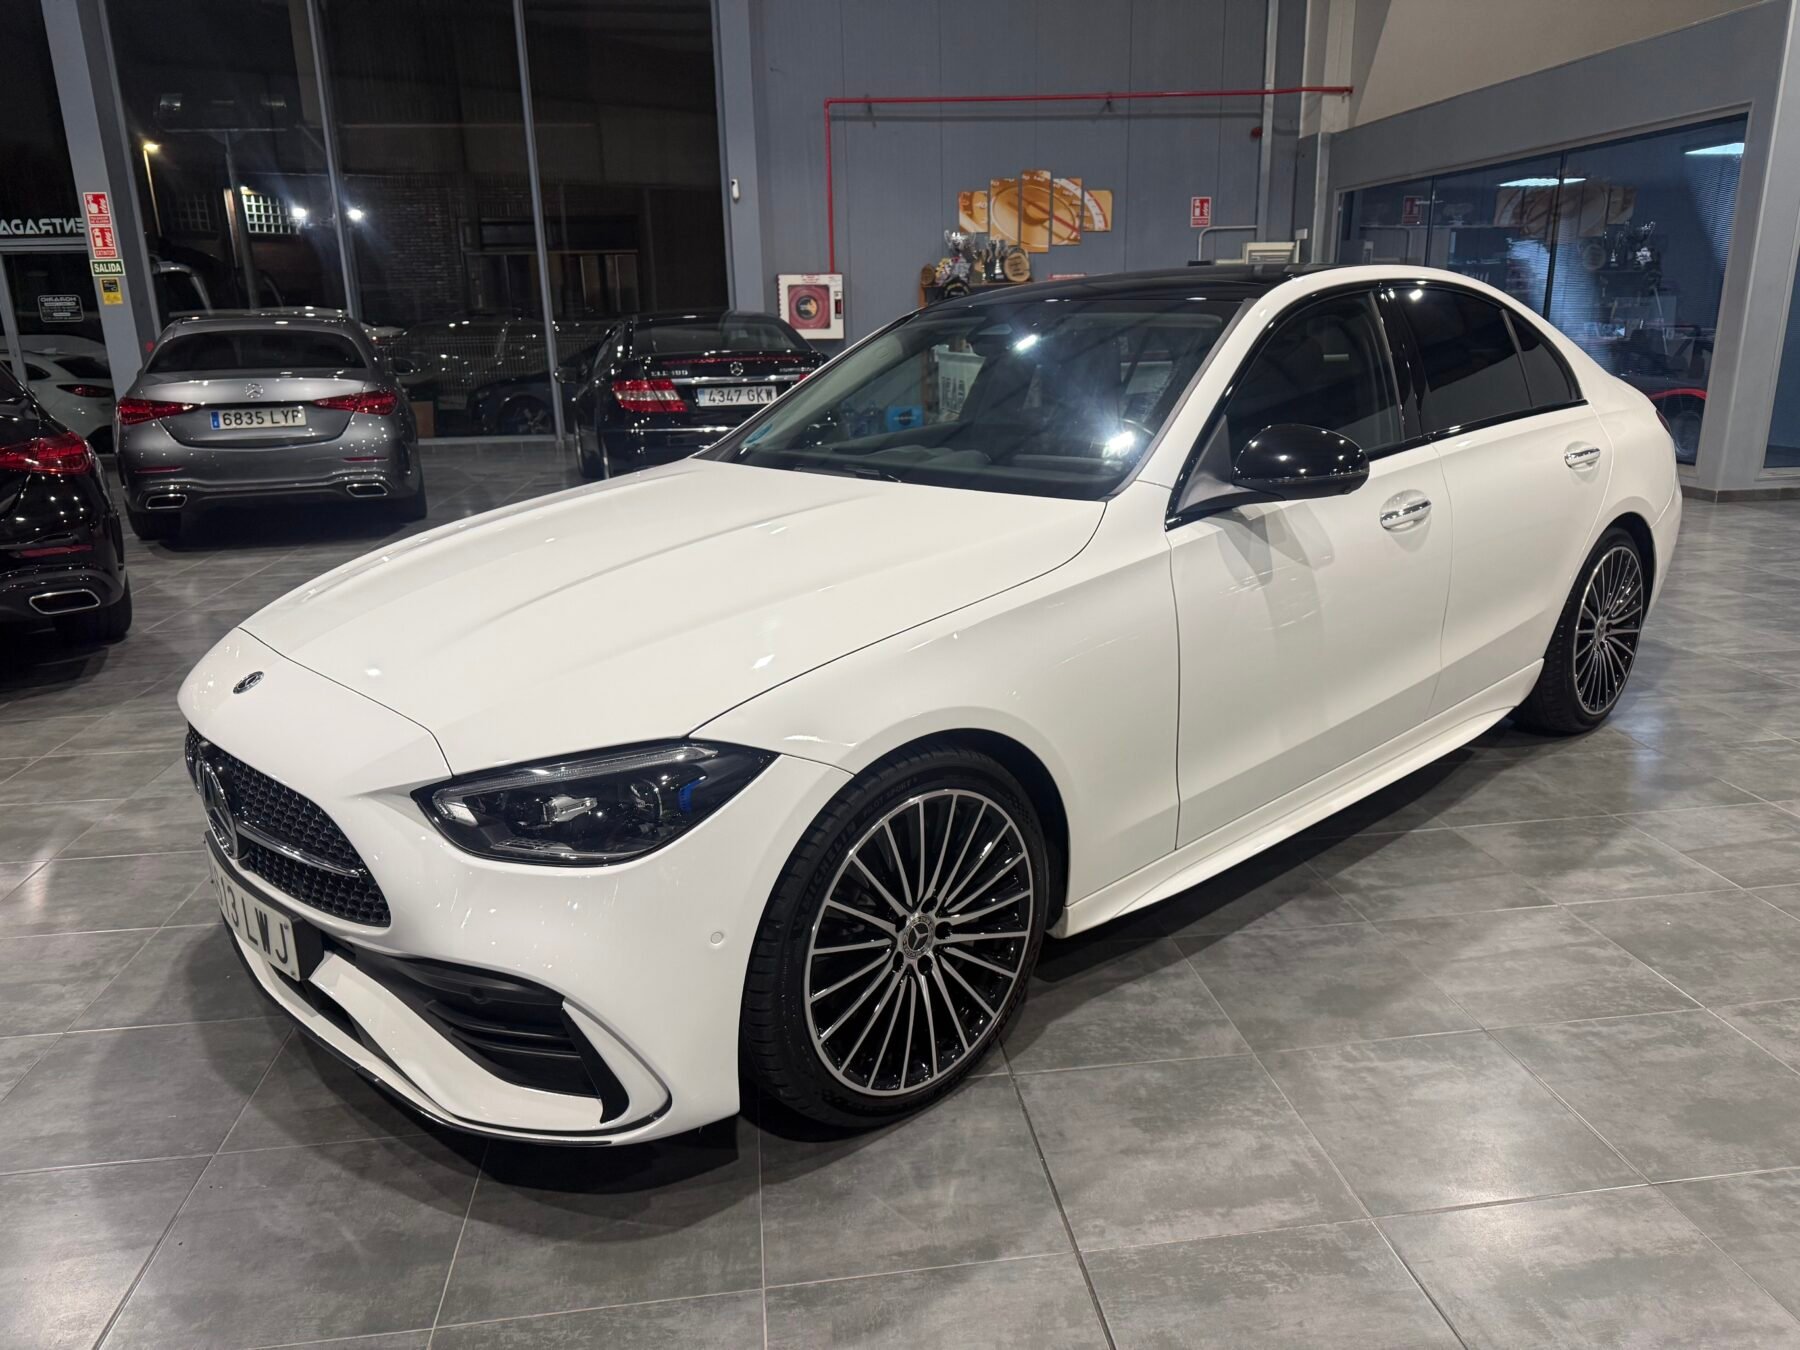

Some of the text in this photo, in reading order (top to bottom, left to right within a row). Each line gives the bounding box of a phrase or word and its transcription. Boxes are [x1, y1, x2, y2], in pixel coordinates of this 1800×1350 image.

[94, 262, 121, 273] SALIDA
[708, 387, 773, 403] 4347 GKW
[222, 411, 265, 426] 6835
[241, 896, 288, 964] LWJ
